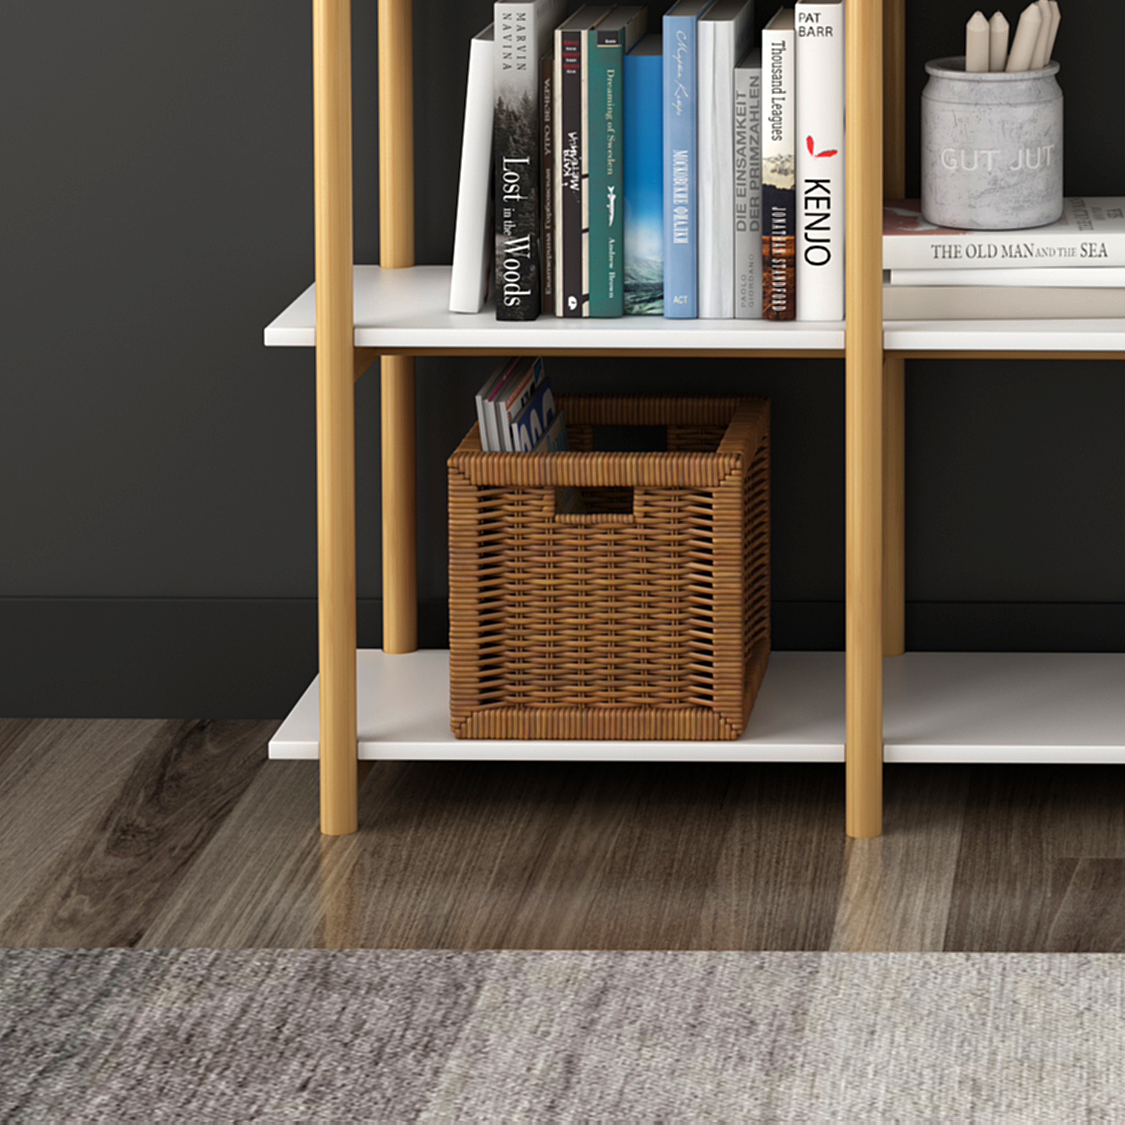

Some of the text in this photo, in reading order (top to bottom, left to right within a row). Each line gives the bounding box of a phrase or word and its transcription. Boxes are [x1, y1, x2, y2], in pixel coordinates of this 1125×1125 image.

[502, 12, 512, 71] NAVINA
[516, 12, 526, 71] MARVIN
[798, 12, 821, 23] PAT
[798, 26, 834, 37] BARR
[606, 69, 615, 175] Dreaming of Sweden
[768, 40, 786, 142] Thousand Leagues
[736, 90, 747, 232] DIE EINSAMKEIT
[749, 76, 760, 232] DER PRIMZAHLEN
[941, 144, 1054, 171] GUT JUT
[503, 156, 531, 307] Lost in the Woods
[804, 179, 831, 266] KENJO
[931, 242, 1108, 259] THE OLD MAN AND THE SEA
